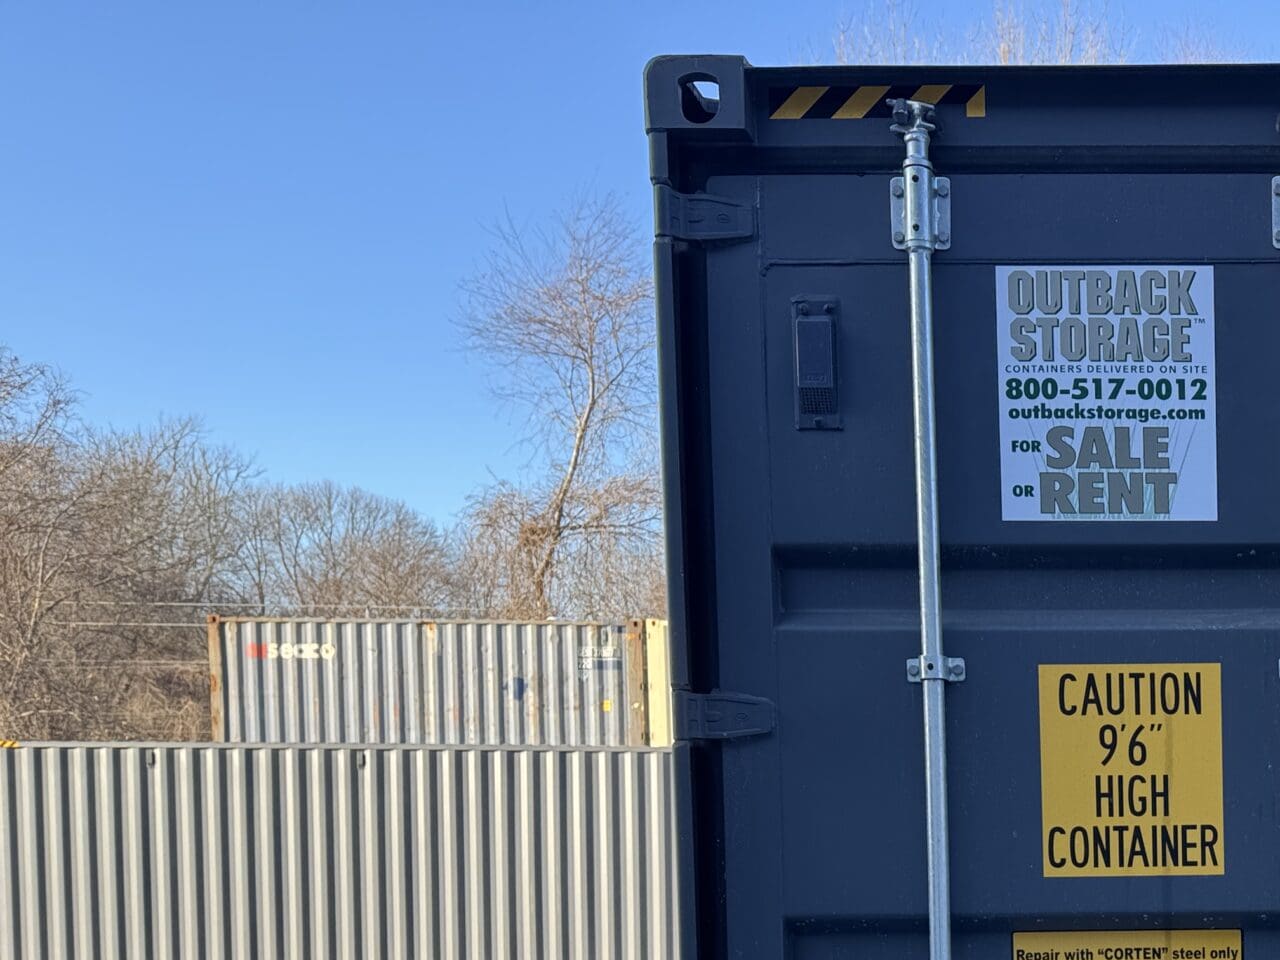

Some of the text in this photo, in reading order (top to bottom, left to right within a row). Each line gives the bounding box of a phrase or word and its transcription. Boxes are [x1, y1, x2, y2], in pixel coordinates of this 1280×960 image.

[1007, 270, 1199, 315] OUTBACK
[1010, 317, 1193, 362] STORAGE
[1005, 365, 1208, 374] CONTAINERS DELIVERED ON SITE
[1005, 378, 1208, 401] 800-517-0012
[1008, 403, 1206, 423] outbackstorage.com
[1011, 425, 1170, 470] FOR SALE
[1012, 472, 1178, 514] OR RENT
[1058, 672, 1202, 716] CAUTION
[1095, 774, 1170, 818] HIGH
[1049, 824, 1219, 868] CONTAINER
[1064, 948, 1093, 960] with
[1172, 947, 1205, 959] steel
